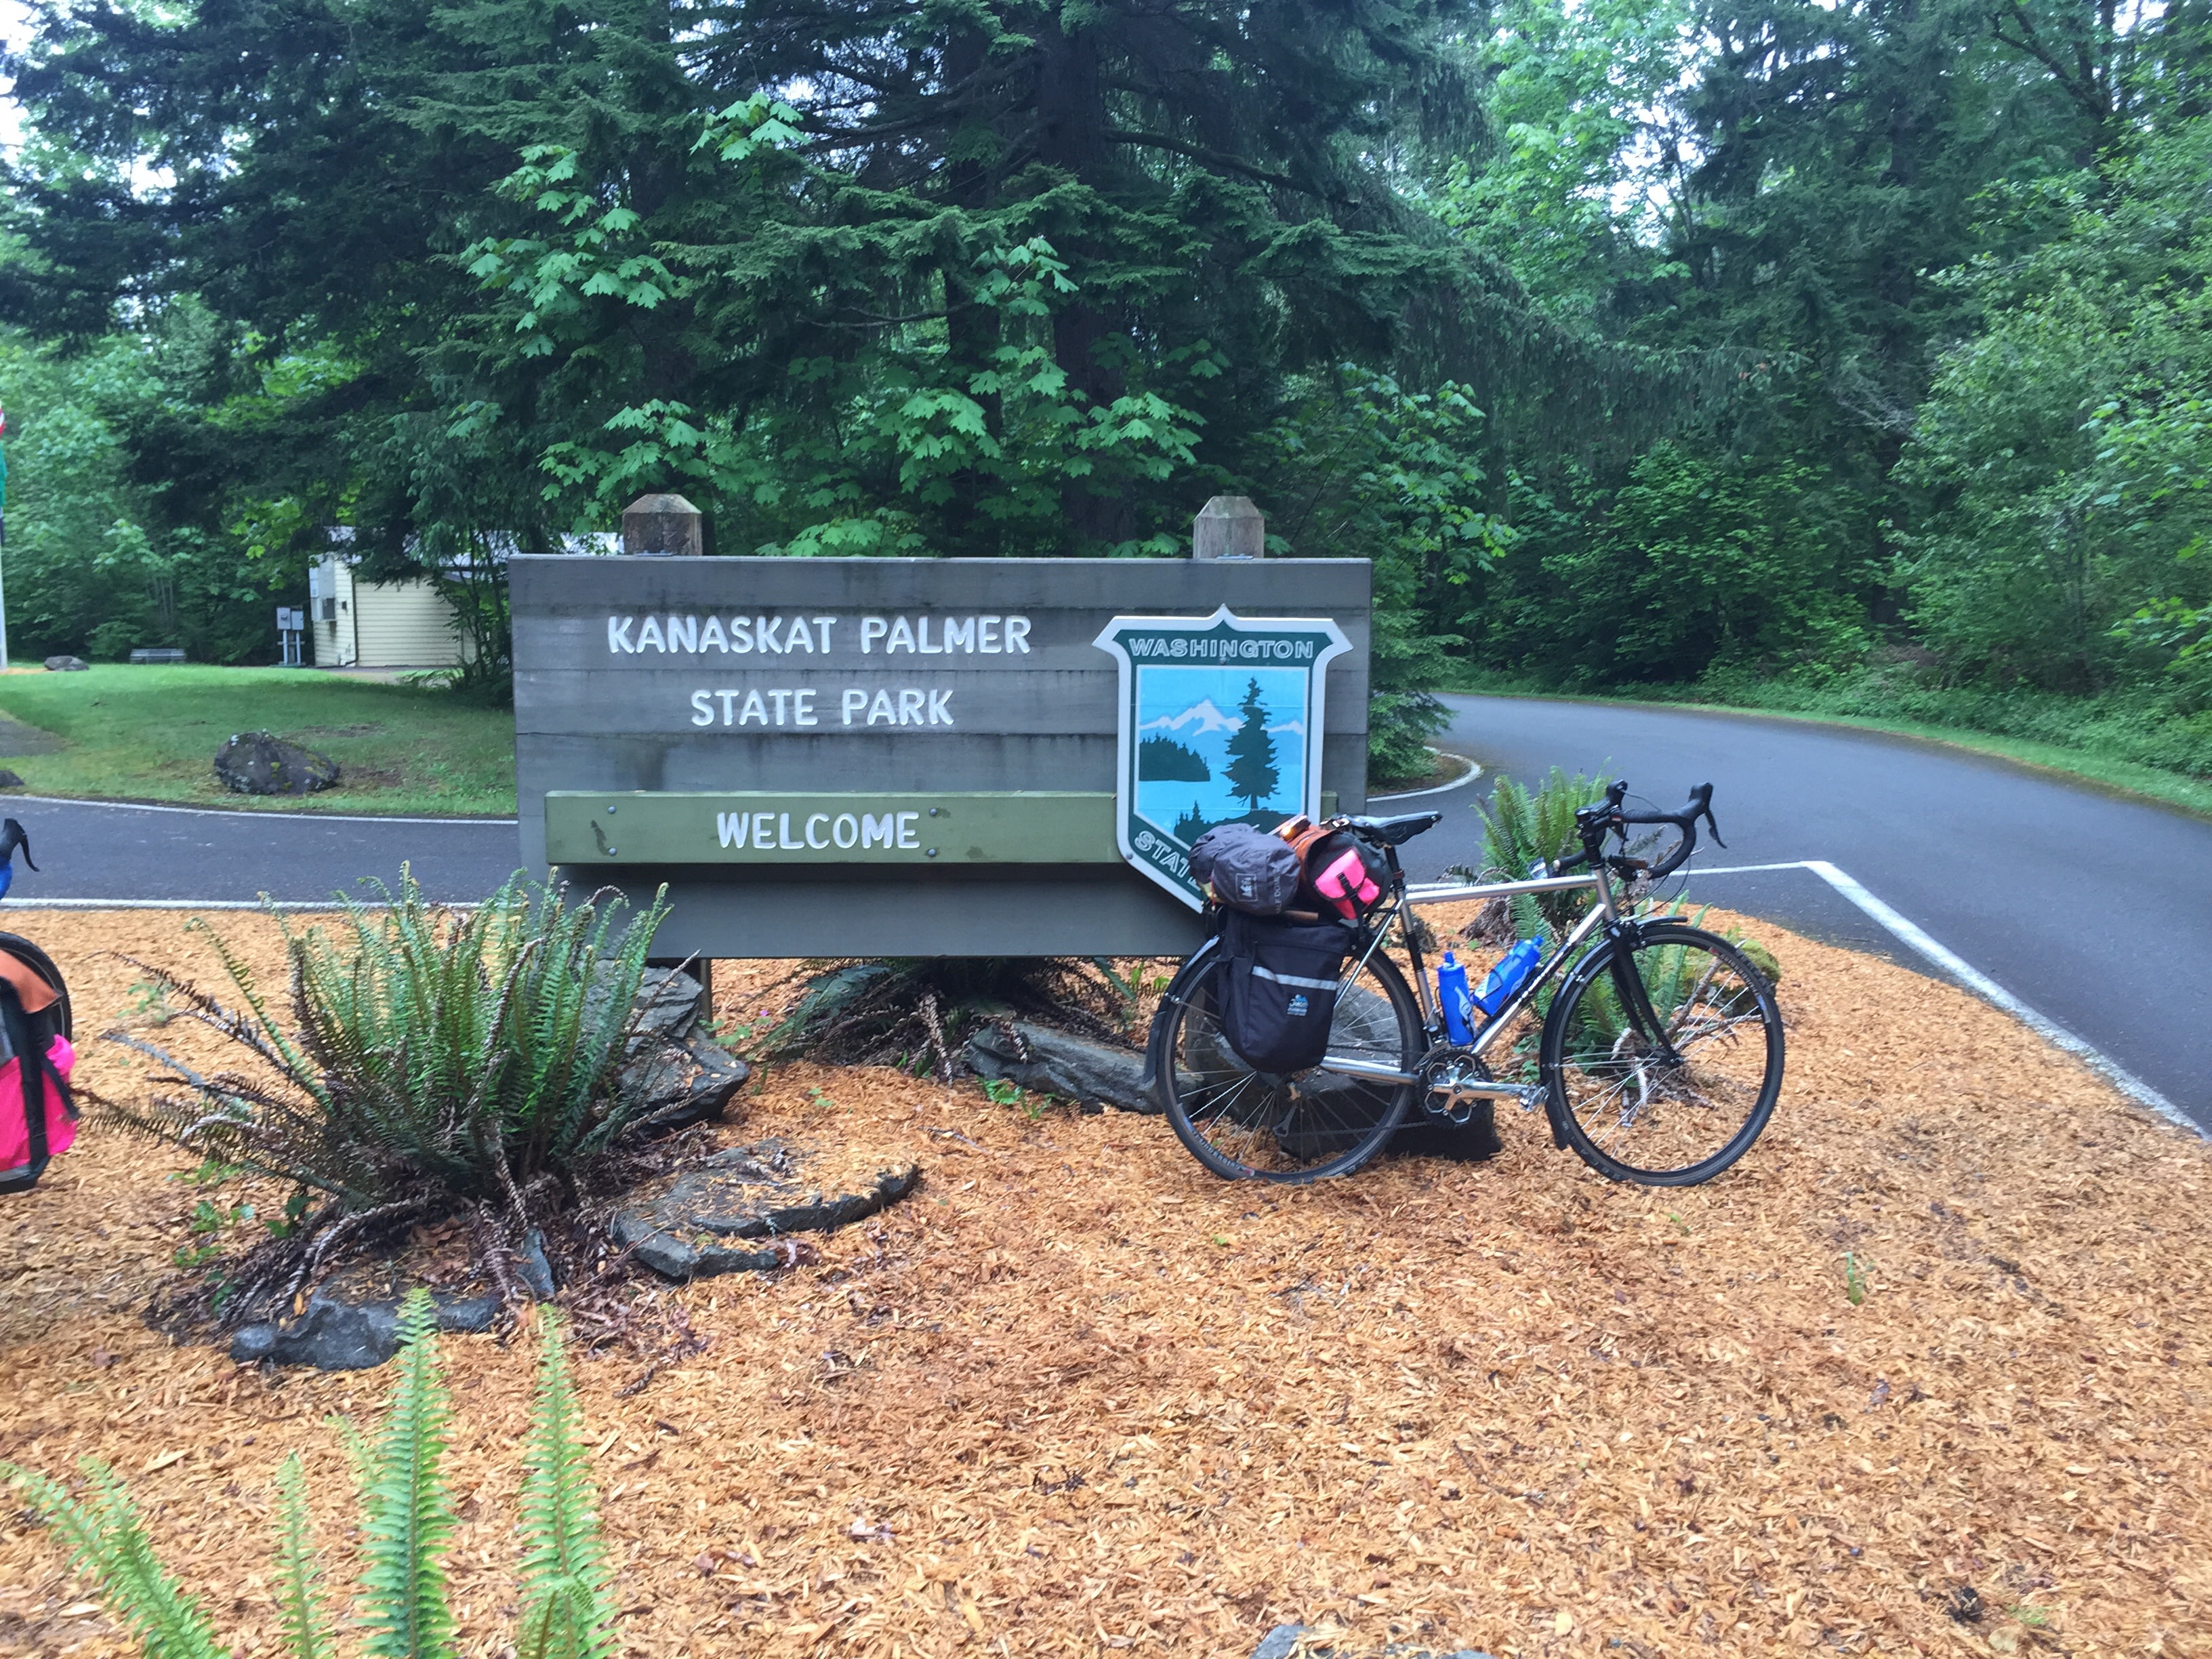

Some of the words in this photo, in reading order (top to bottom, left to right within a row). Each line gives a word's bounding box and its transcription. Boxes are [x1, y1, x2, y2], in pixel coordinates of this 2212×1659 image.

[609, 615, 837, 654] KANASKAT
[860, 615, 1032, 654] PALMER
[1128, 638, 1314, 659] WASHINGTON
[691, 689, 819, 726] STATE
[842, 689, 955, 726] PARK
[716, 811, 921, 850] WELCOME
